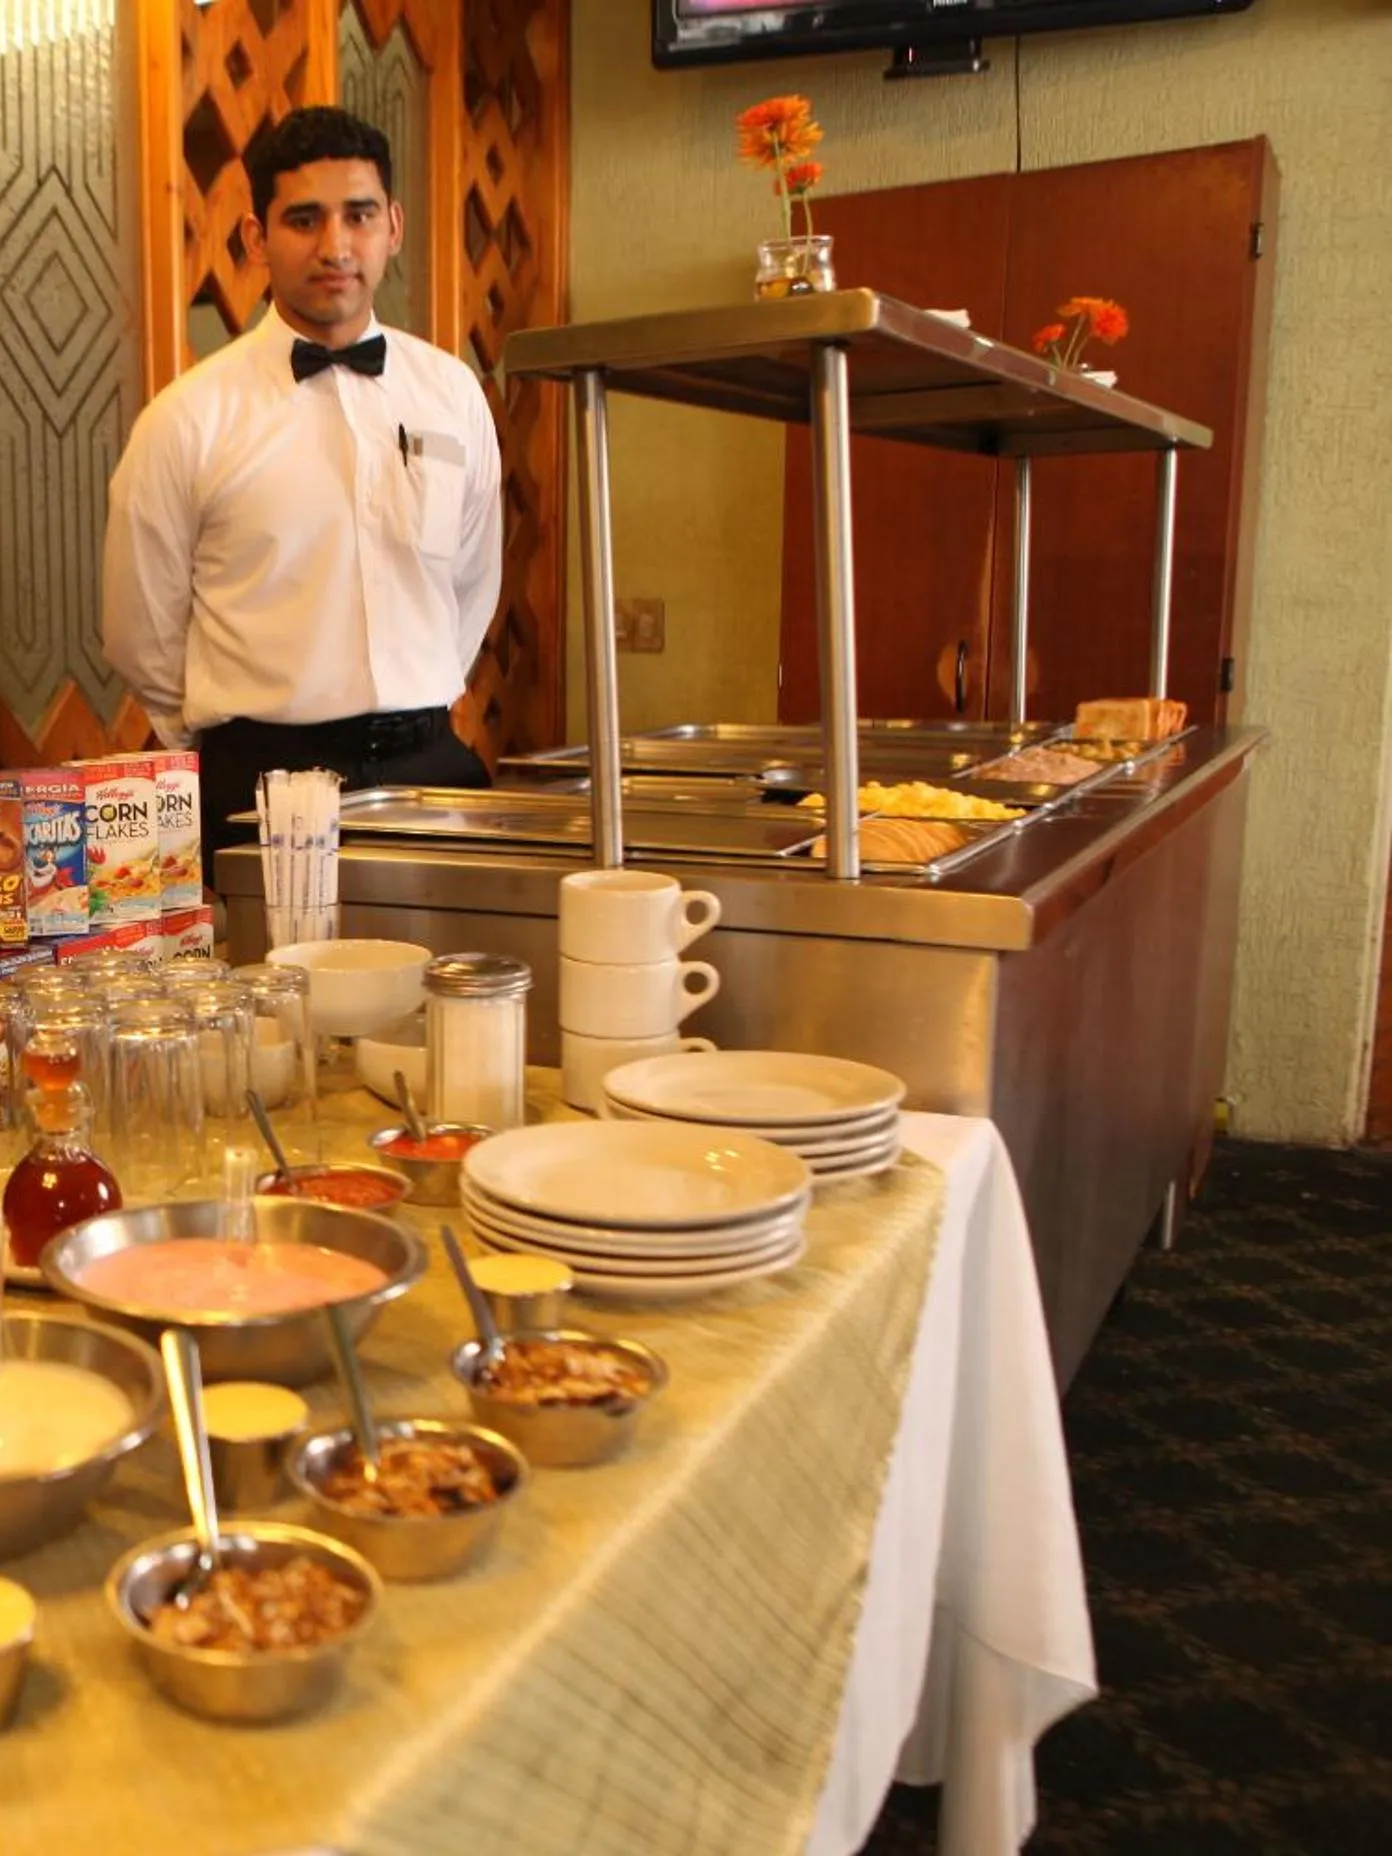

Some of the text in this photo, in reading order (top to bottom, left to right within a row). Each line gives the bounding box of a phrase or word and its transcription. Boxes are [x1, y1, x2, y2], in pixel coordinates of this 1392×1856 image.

[86, 802, 148, 824] CORN
[156, 792, 192, 813] ORN
[24, 810, 81, 844] CARITAS
[157, 811, 193, 828] AKES
[85, 822, 149, 840] FLAKES
